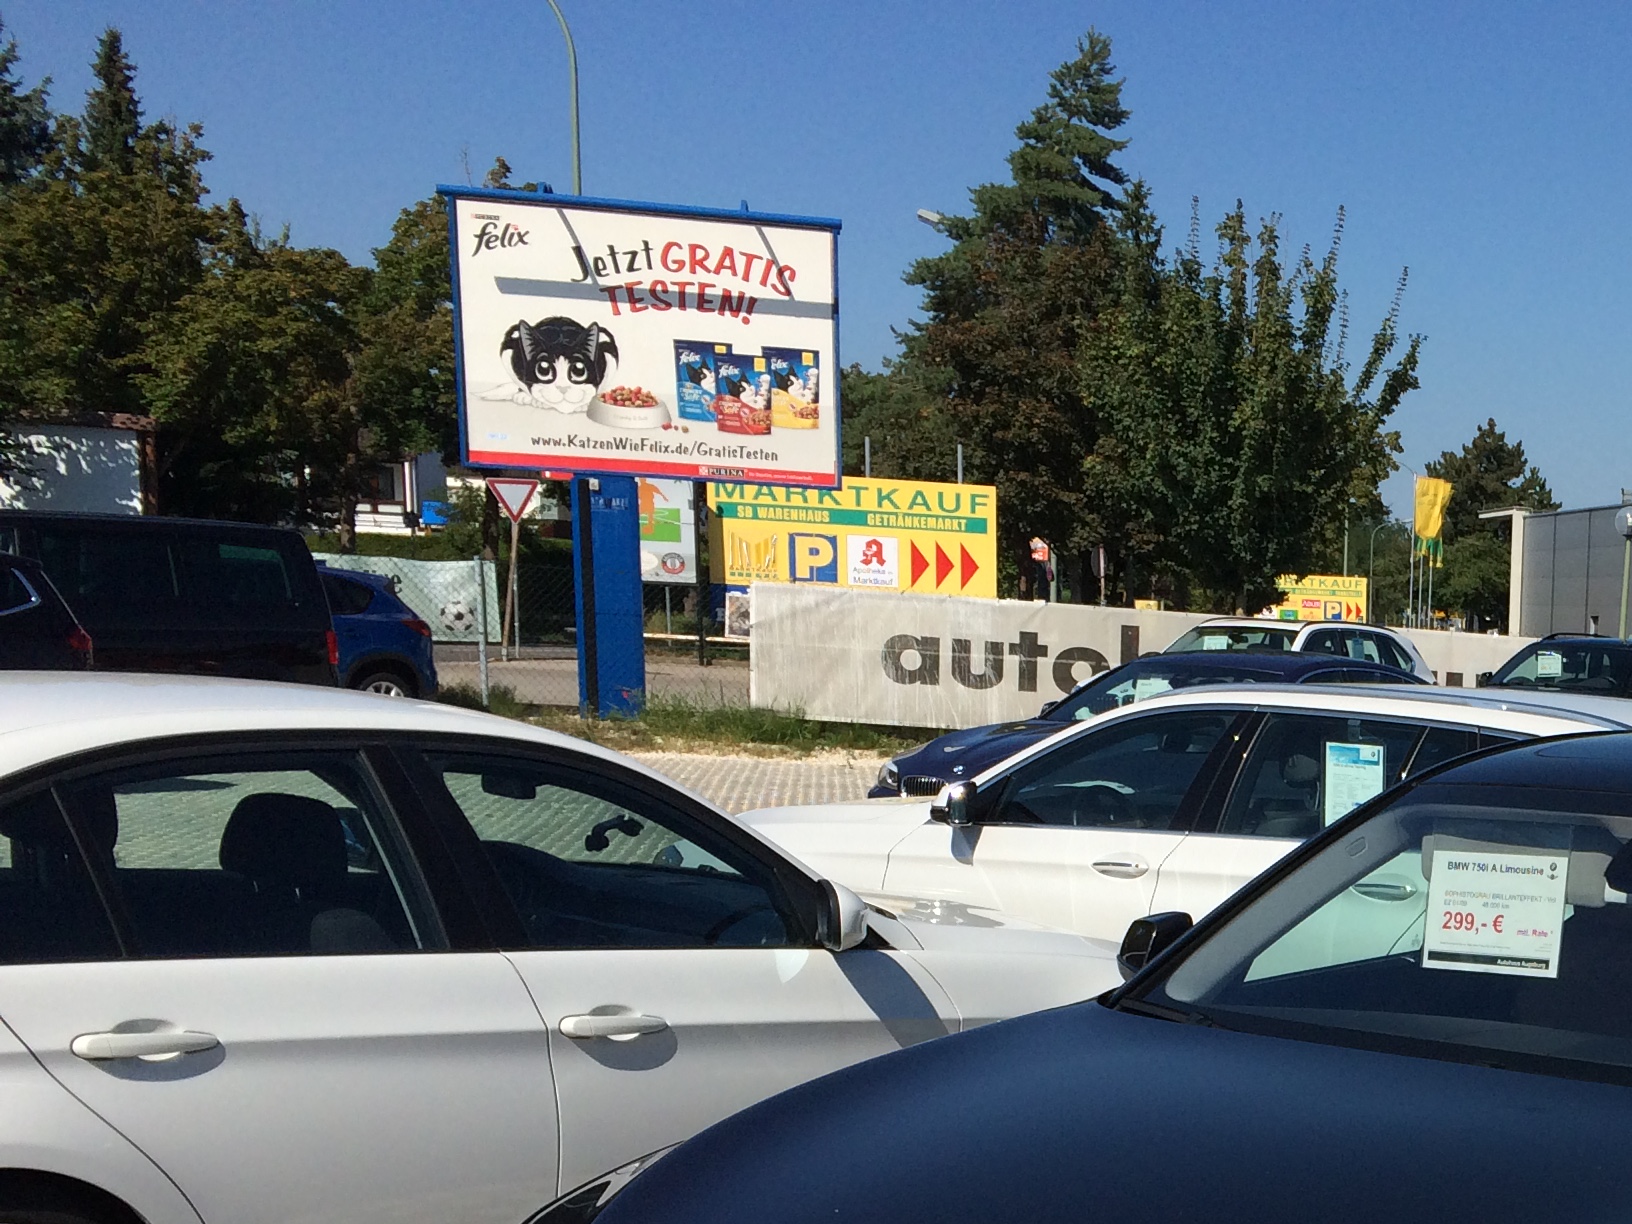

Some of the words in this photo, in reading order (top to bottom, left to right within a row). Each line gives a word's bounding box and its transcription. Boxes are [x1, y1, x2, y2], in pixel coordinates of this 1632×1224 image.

[472, 222, 529, 257] felix
[571, 240, 653, 283] Jetzt
[660, 241, 796, 297] GRATIS
[599, 281, 758, 325] TESTEN!
[531, 434, 778, 462] www.KatzenWieFelix.de/GratisTesten
[708, 468, 744, 477] PURINA
[737, 505, 753, 518] SB
[757, 506, 830, 522] WARENHAUS
[867, 512, 967, 531] GETRÄNKEMARKT
[794, 536, 834, 579] P
[853, 576, 893, 586] Marktkauf
[1448, 861, 1470, 871] BMW
[1472, 862, 1488, 872] 750i
[1490, 864, 1498, 873] A
[1500, 864, 1544, 876] Limousine
[1442, 911, 1488, 935] 299,-
[1492, 914, 1505, 934] €
